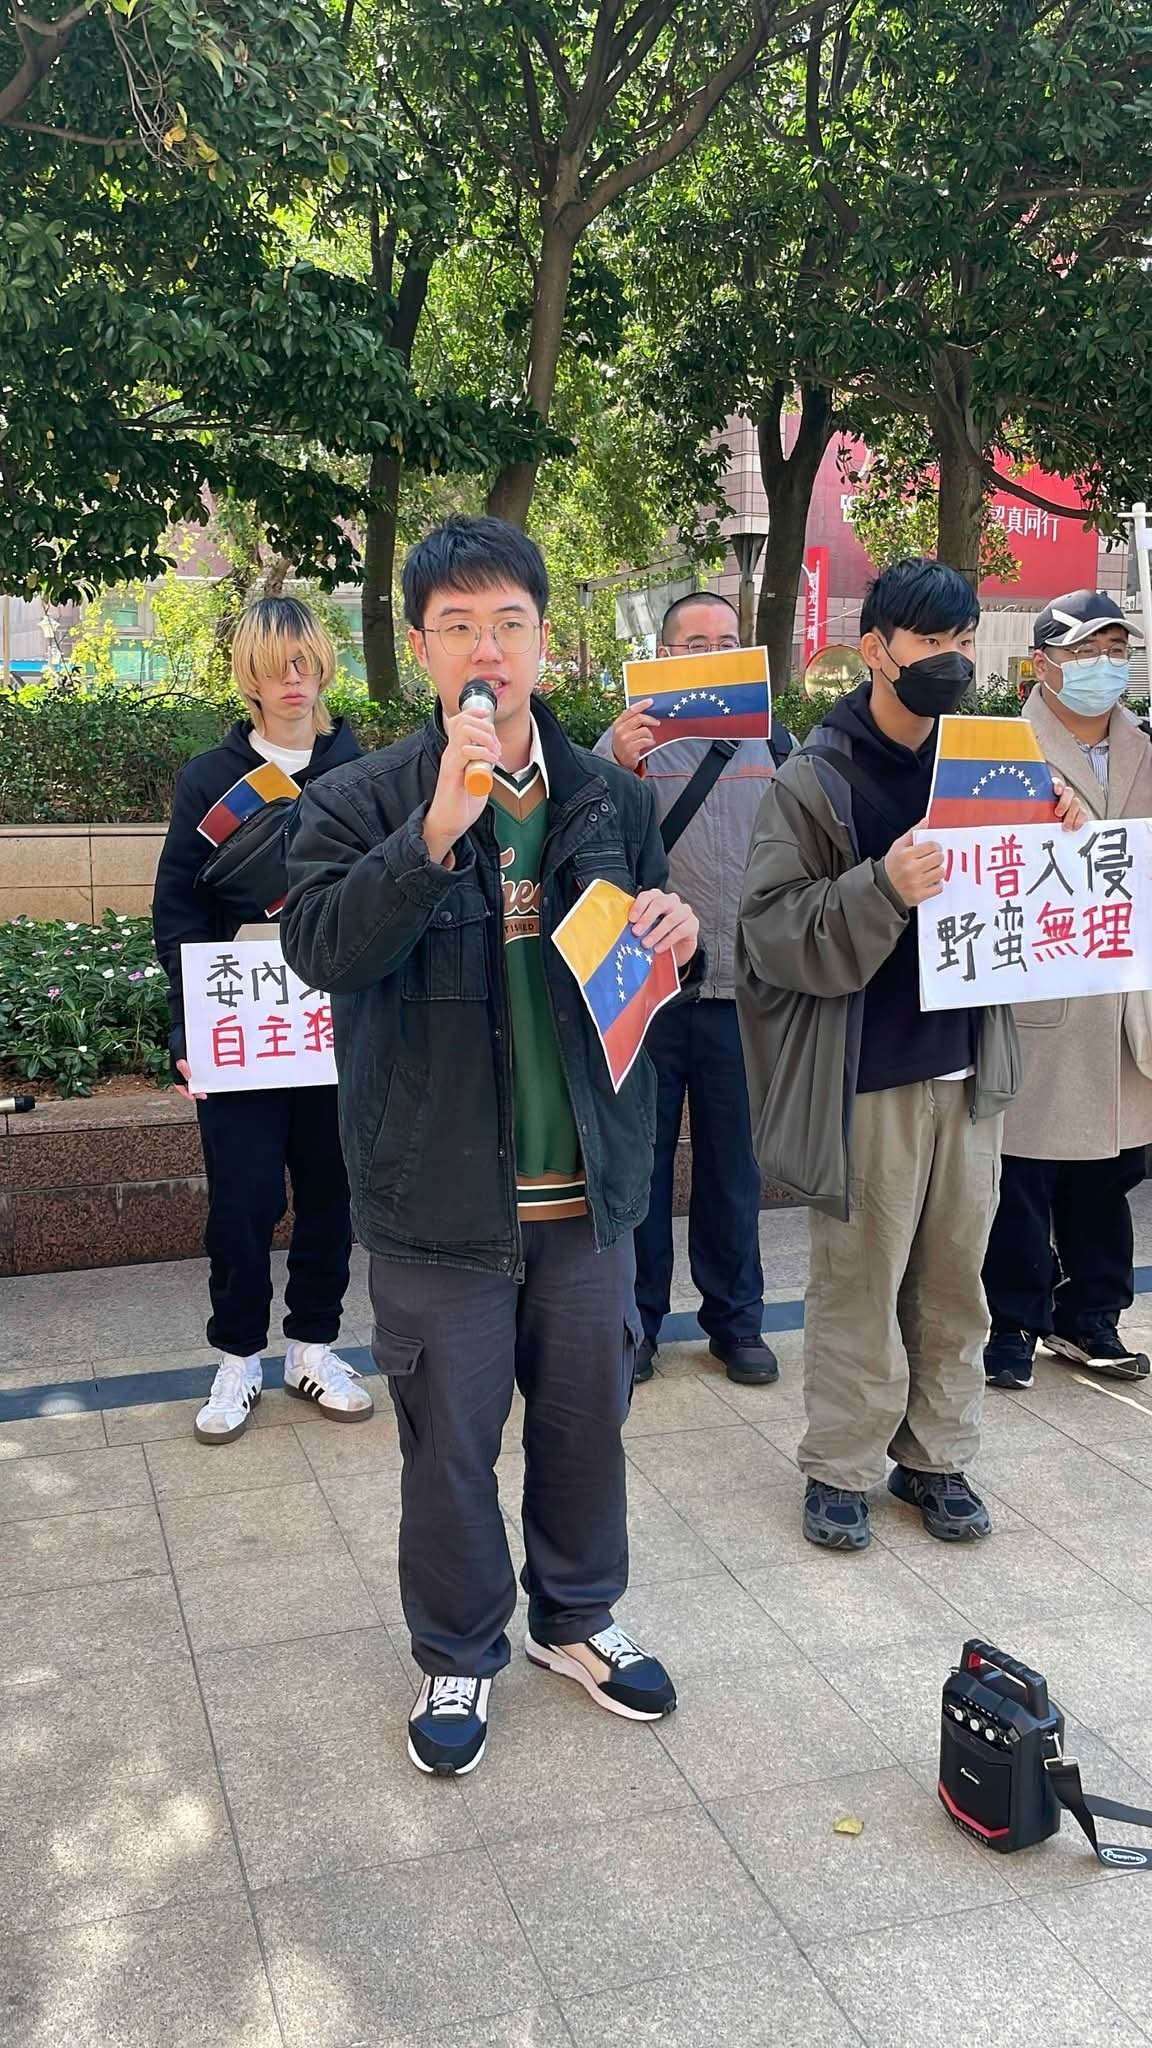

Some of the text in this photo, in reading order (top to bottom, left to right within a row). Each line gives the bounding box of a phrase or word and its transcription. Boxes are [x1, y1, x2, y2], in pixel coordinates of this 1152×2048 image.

[943, 827, 1134, 900] 川普入侵
[206, 953, 325, 1008] 委內
